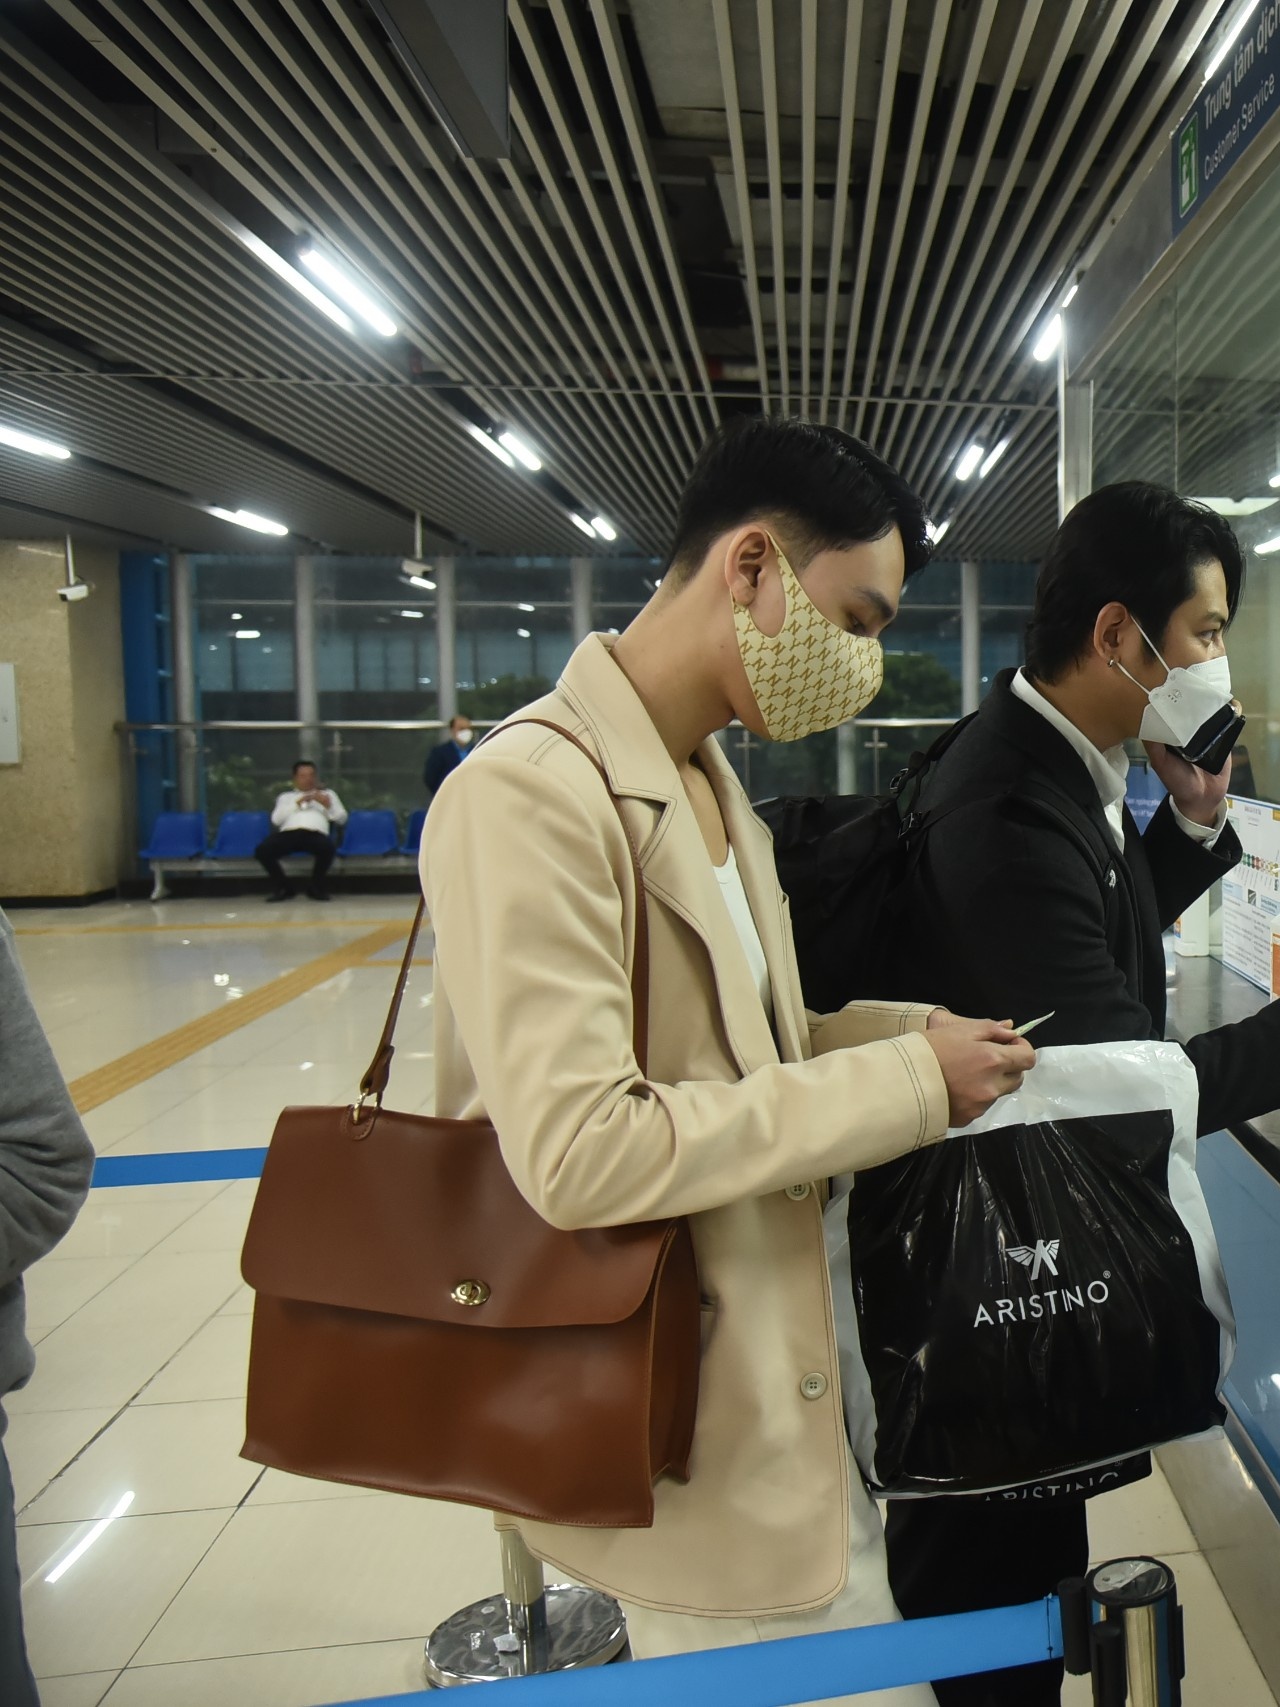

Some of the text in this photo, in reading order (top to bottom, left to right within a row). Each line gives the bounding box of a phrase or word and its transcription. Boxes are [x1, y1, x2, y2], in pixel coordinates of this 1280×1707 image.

[1204, 73, 1231, 129] Trung
[1204, 72, 1275, 180] Customer Service
[974, 1281, 1109, 1328] ARISTINO
